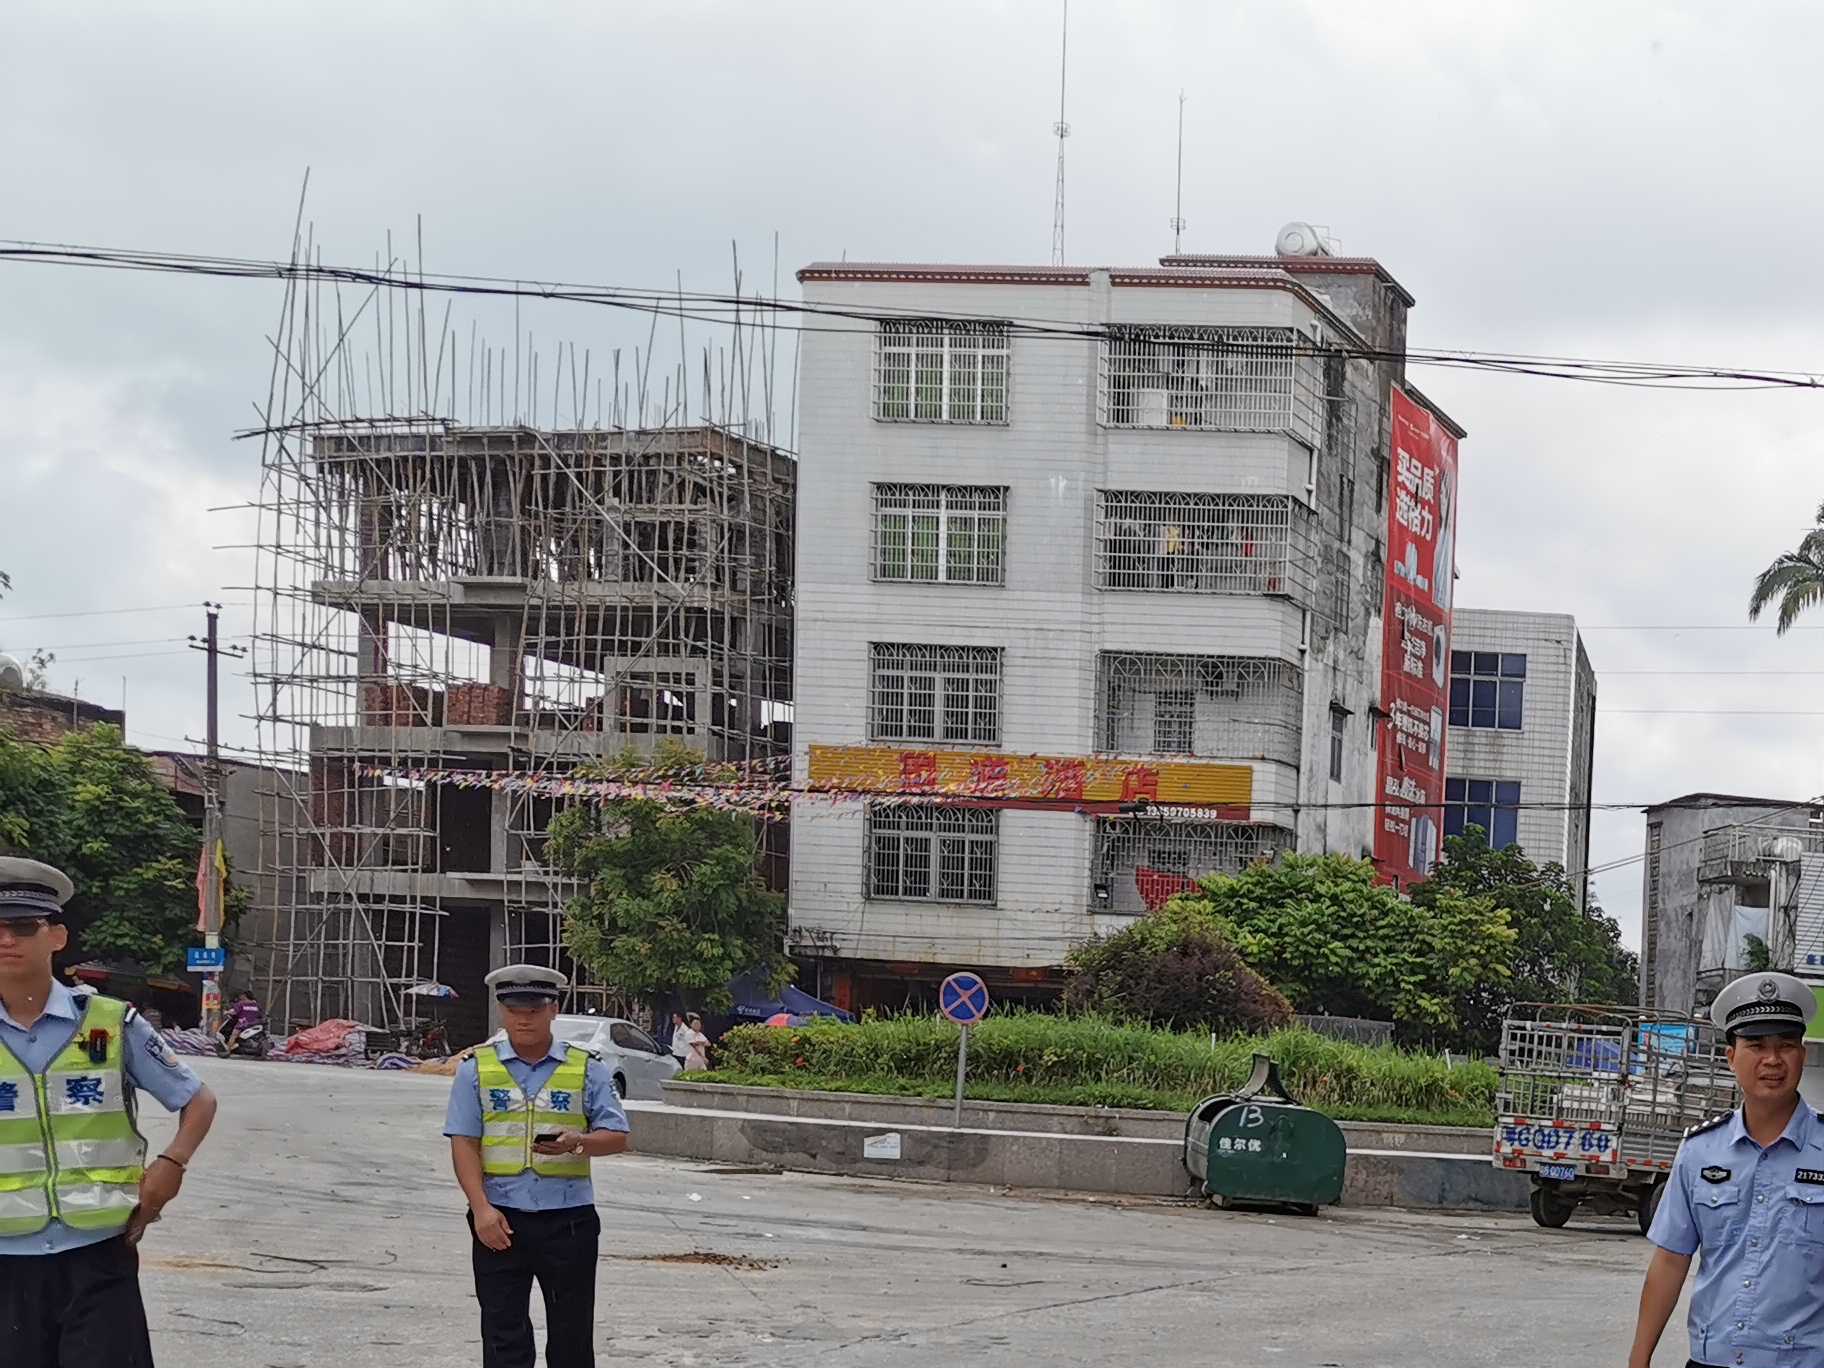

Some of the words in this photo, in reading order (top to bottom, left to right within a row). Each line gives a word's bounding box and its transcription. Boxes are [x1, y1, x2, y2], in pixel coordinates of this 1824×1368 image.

[1397, 447, 1434, 505] 买品质
[489, 1088, 572, 1112] 警察
